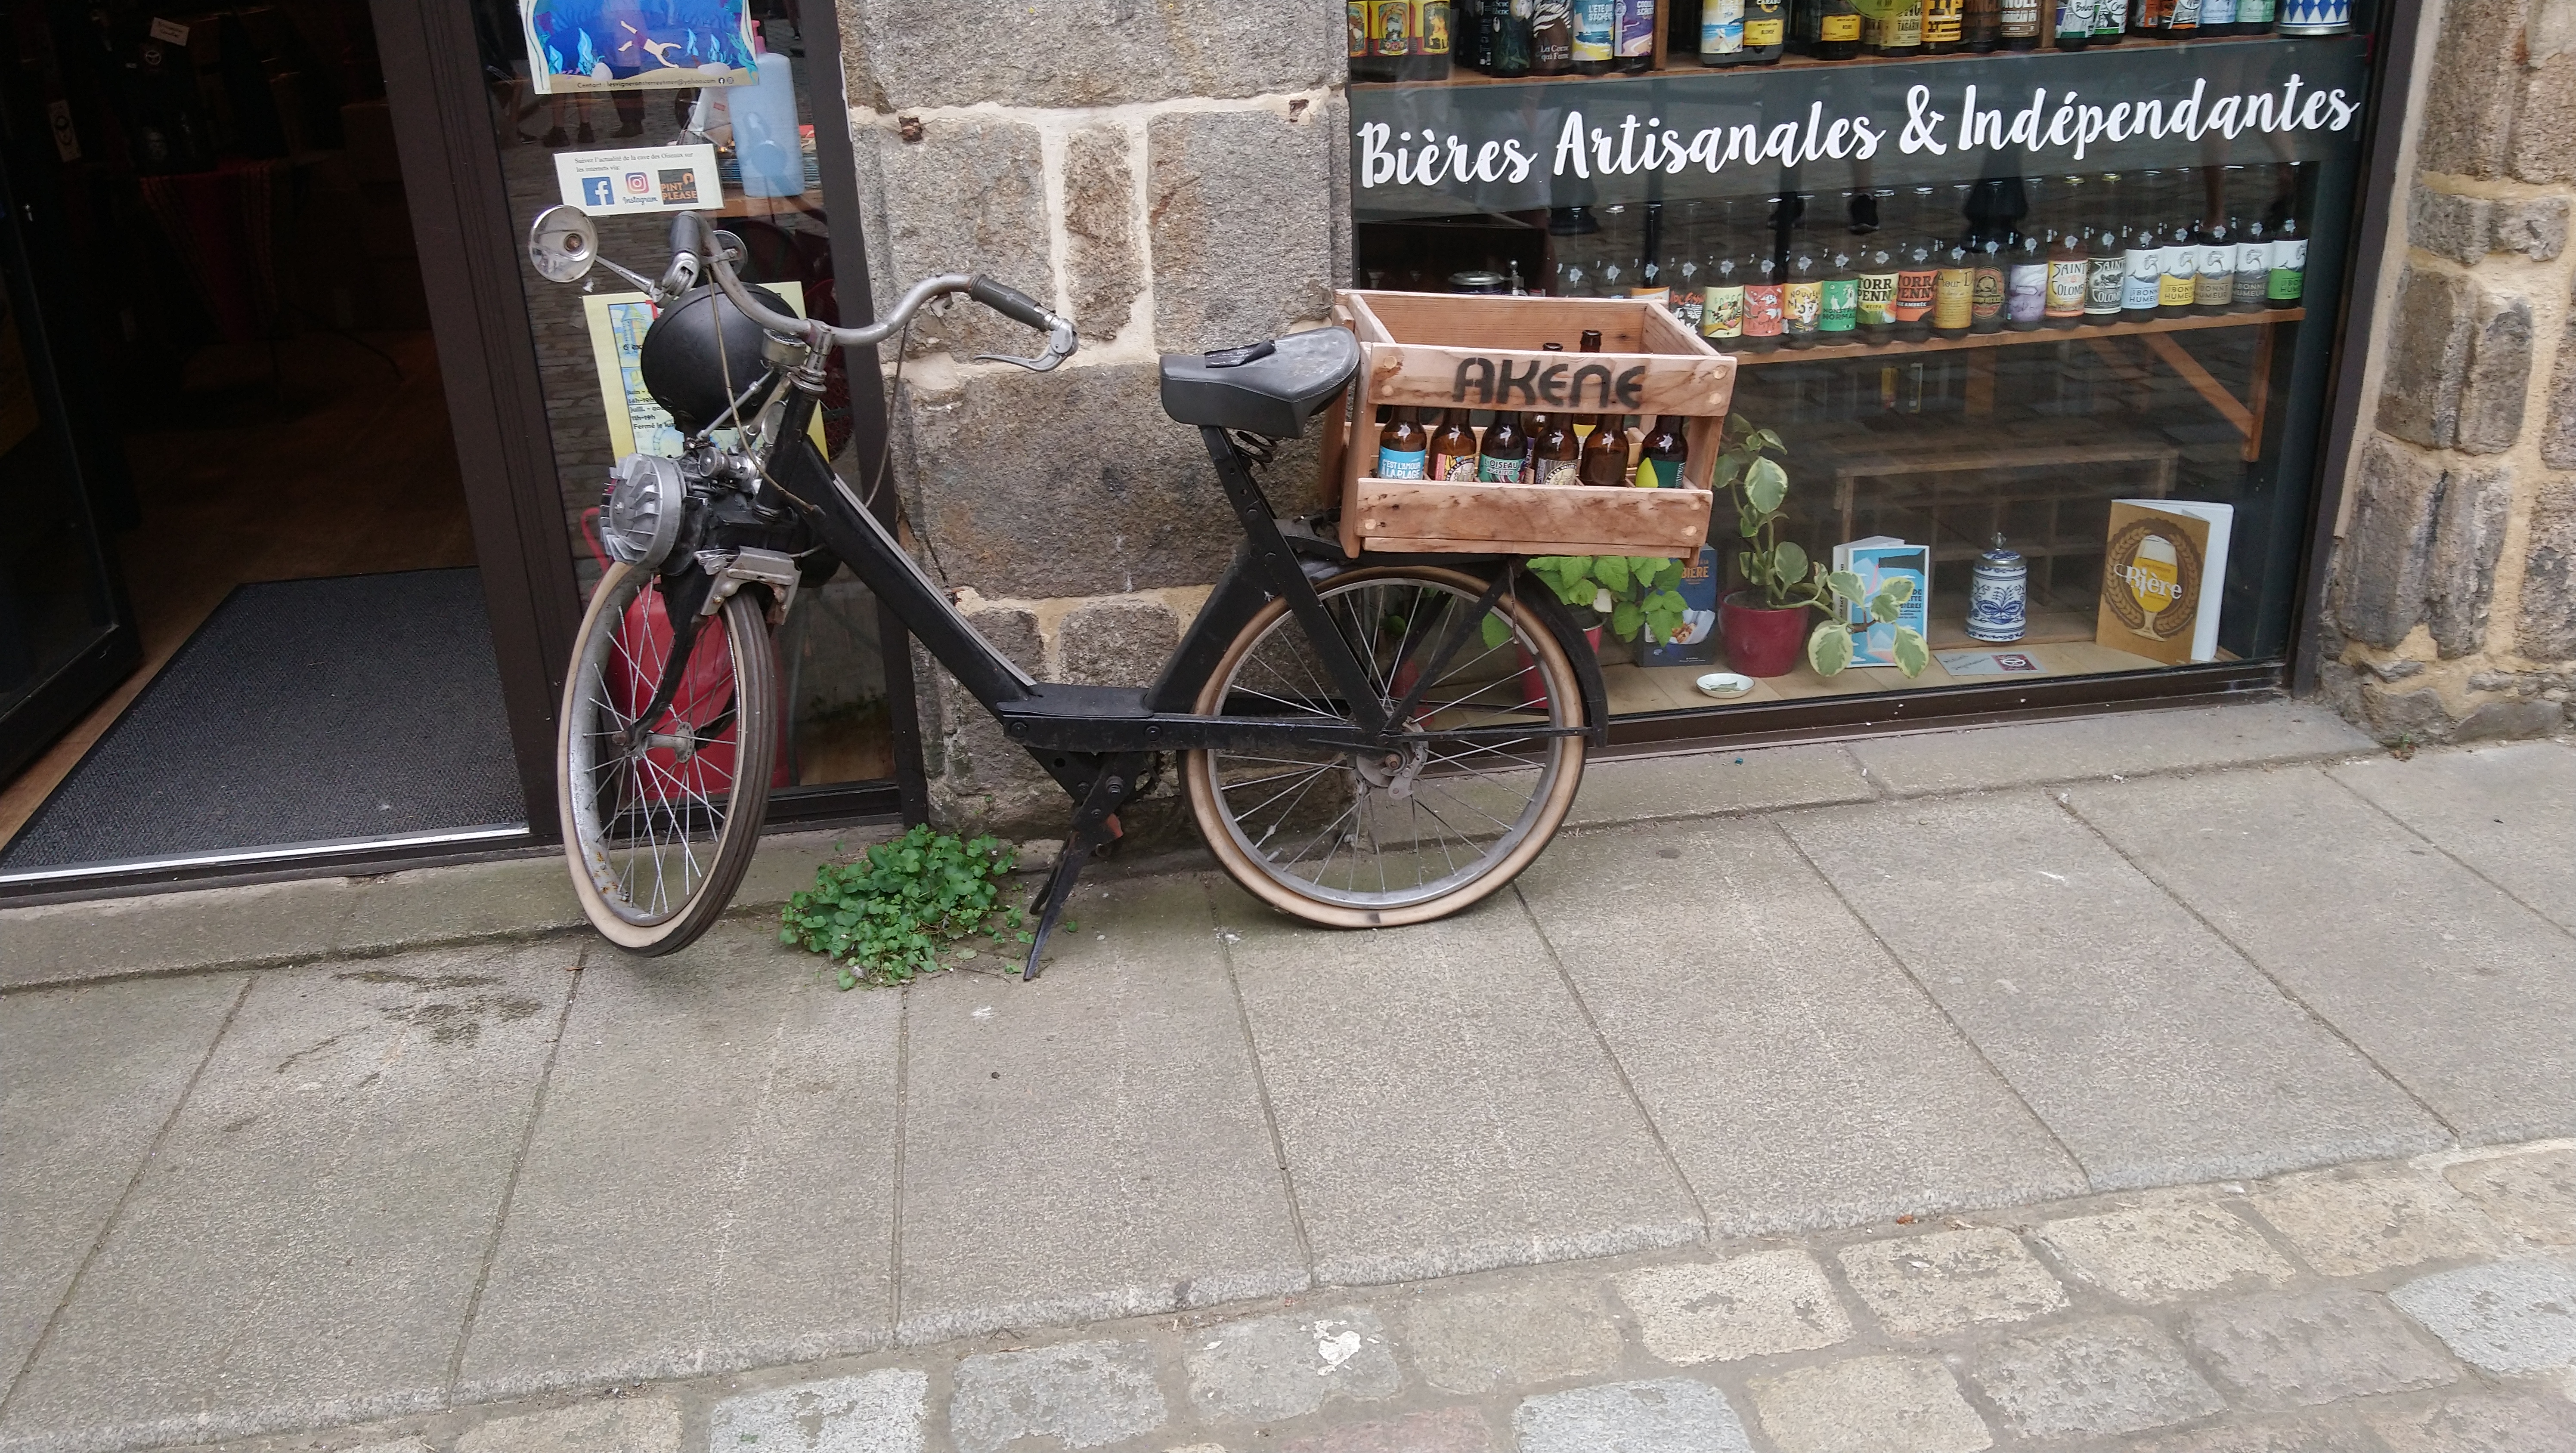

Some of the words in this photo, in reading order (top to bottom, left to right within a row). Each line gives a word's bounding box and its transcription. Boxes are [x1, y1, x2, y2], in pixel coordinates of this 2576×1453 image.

[1357, 121, 1537, 188] Bières
[1553, 101, 1887, 179] Artisanales
[1899, 85, 1947, 155] &
[1958, 73, 2360, 161] Indépendantes
[660, 182, 683, 192] PINT
[662, 190, 697, 201] PLEASE
[622, 196, 658, 206] Instagram
[1452, 357, 1646, 409] AKENE
[633, 421, 655, 430] Fermé
[1382, 458, 1398, 469] C'EST
[1398, 461, 1421, 470] L'AMOUR
[1484, 459, 1519, 469] L'OISEAU
[1386, 469, 1396, 477] LA
[1396, 469, 1420, 479] PLAGE
[1486, 467, 1514, 476] MIGRATEUR
[2114, 563, 2183, 600] Bière
